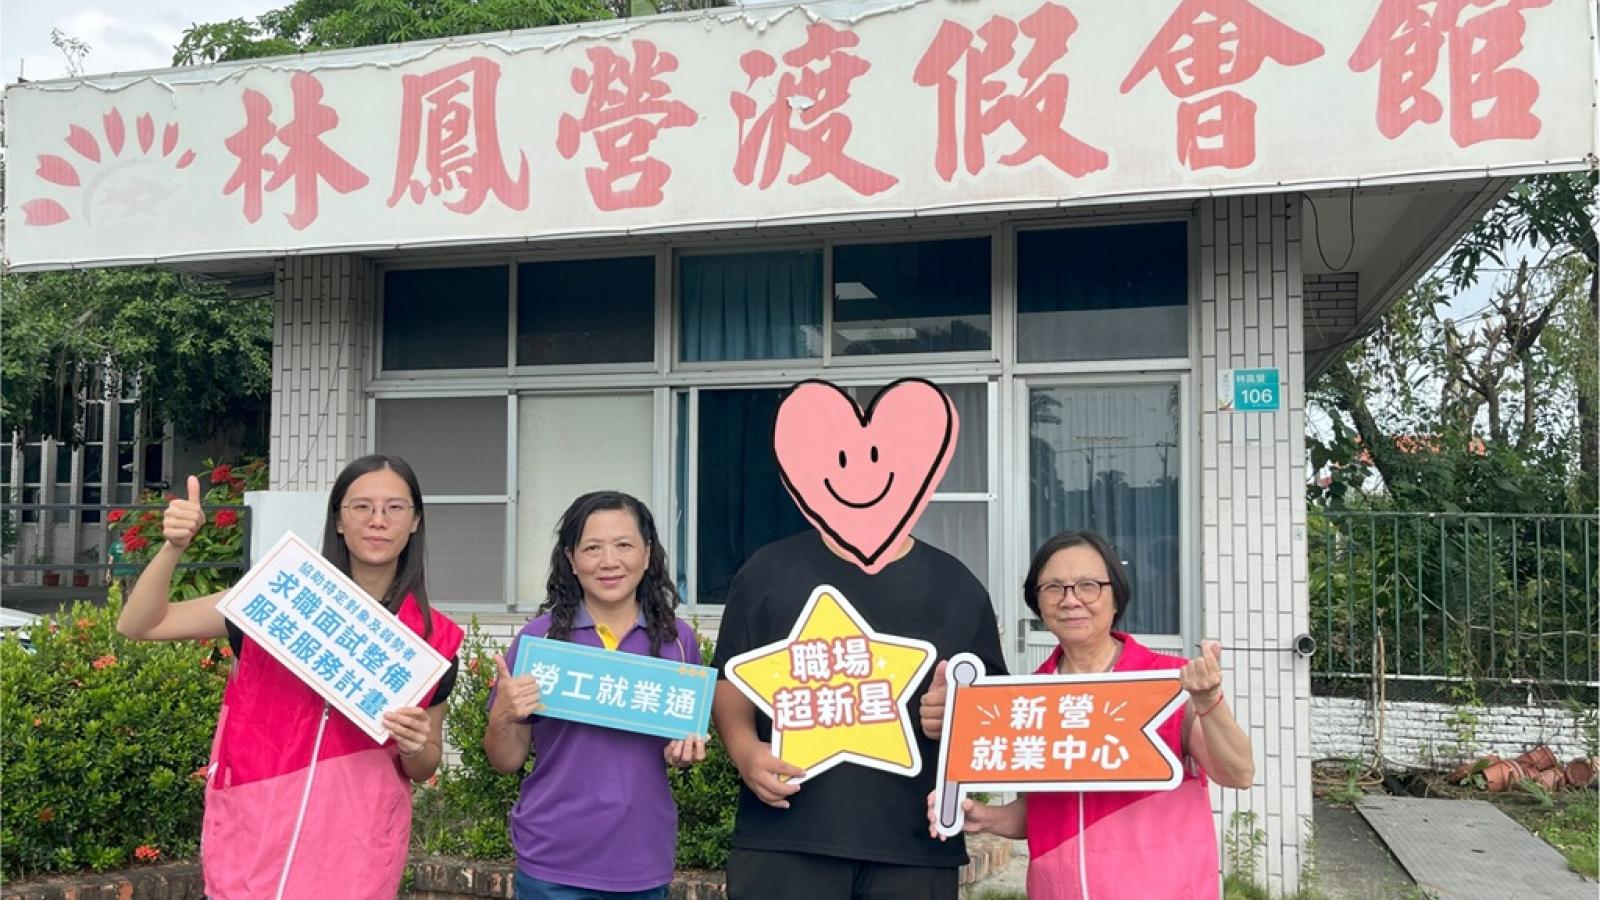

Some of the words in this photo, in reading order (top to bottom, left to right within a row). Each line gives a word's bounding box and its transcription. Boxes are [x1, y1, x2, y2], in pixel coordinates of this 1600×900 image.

[223, 0, 1552, 231] 林鳳營渡假會館
[1241, 388, 1273, 404] 106
[269, 570, 412, 694] 求職面試整備
[299, 560, 417, 662] 協助特定對象及弱勢者
[241, 593, 389, 720] 服裝服務計畫
[790, 636, 872, 683] 職場
[529, 661, 697, 720] 勞工就業通
[773, 681, 898, 730] 超新星
[1010, 694, 1094, 730] 新營
[970, 734, 1129, 771] 就業中心
